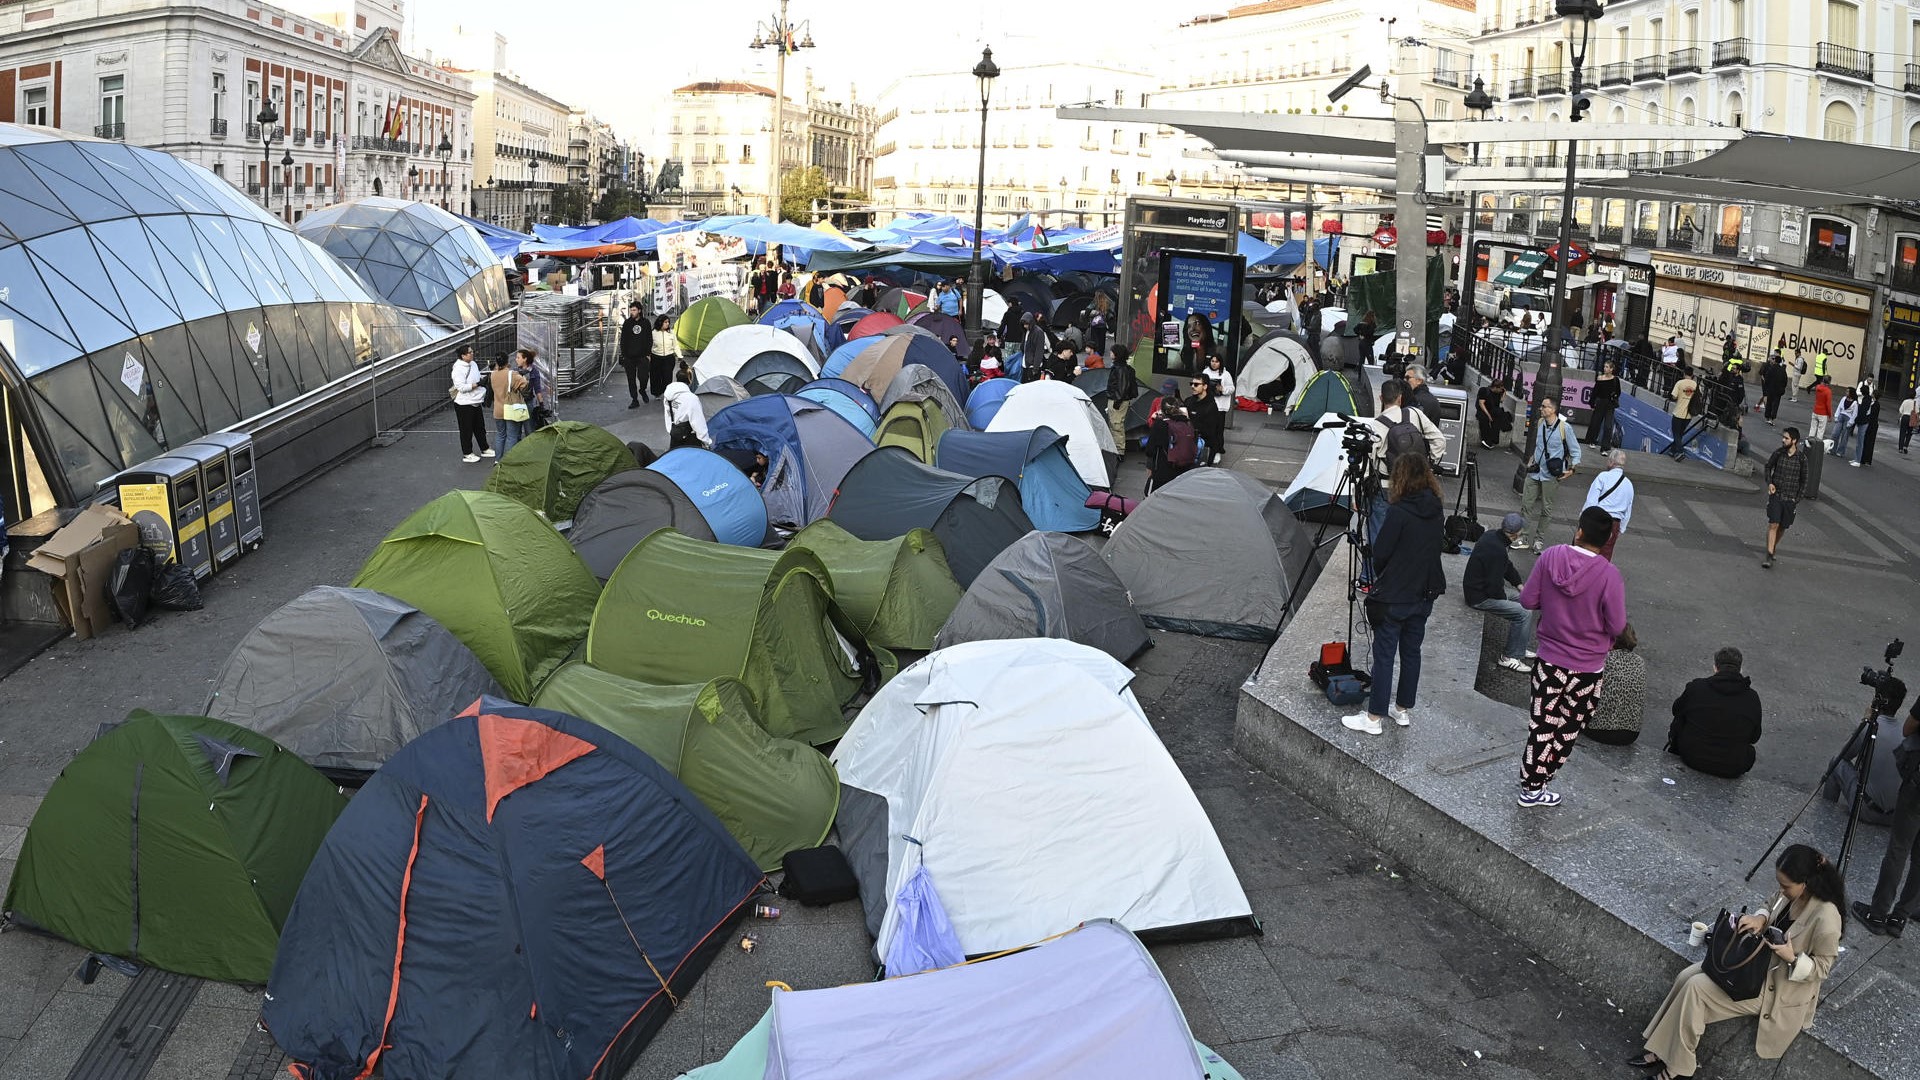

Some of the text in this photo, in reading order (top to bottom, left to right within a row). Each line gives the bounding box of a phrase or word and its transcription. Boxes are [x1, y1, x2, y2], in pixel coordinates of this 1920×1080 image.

[1187, 216, 1216, 225] PlayRenfe
[1663, 263, 1725, 283] CASA DE DIEGO
[1799, 284, 1845, 304] DIEGO
[1656, 306, 1728, 341] PARAGUAS
[1752, 329, 1770, 343] DIEGO
[1780, 332, 1856, 360] ABANICOS
[702, 482, 729, 497] Quechua
[646, 609, 706, 627] Quechua
